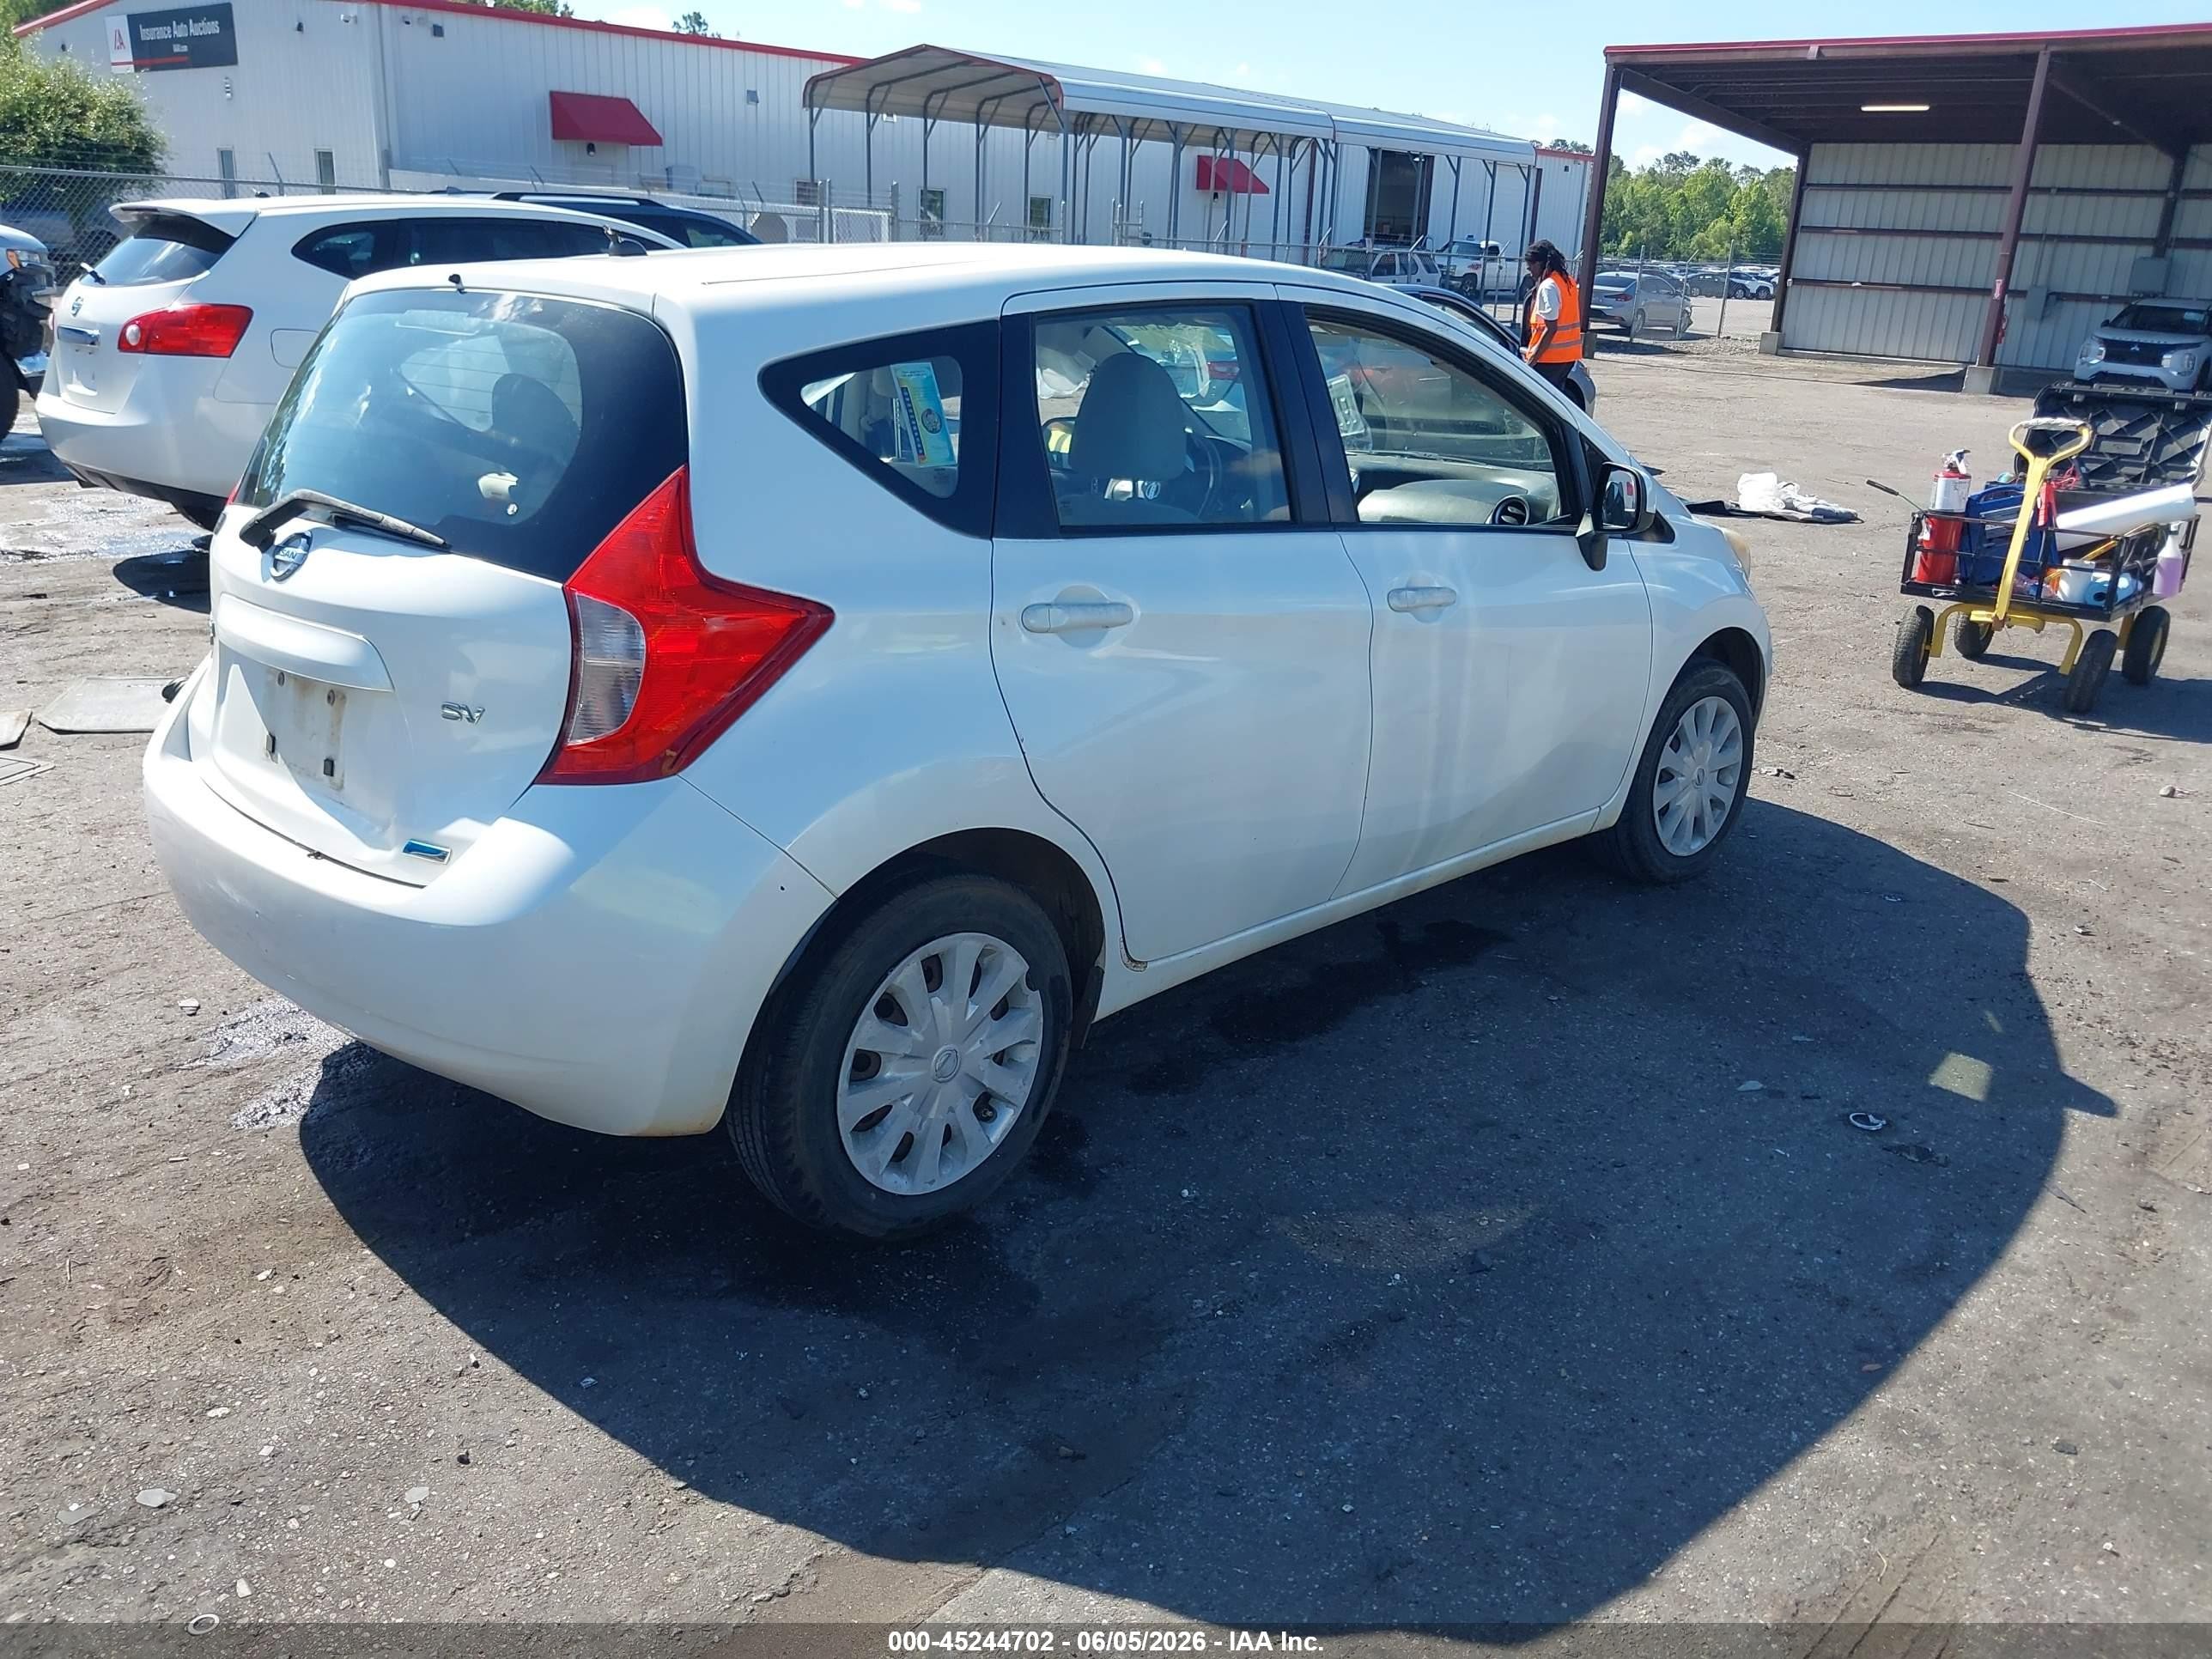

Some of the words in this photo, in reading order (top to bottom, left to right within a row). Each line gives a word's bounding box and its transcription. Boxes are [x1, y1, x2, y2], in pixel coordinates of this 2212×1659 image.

[139, 23, 172, 41] Insurance
[173, 20, 188, 39] Auto
[189, 17, 220, 37] Auctions
[441, 701, 486, 725] SV
